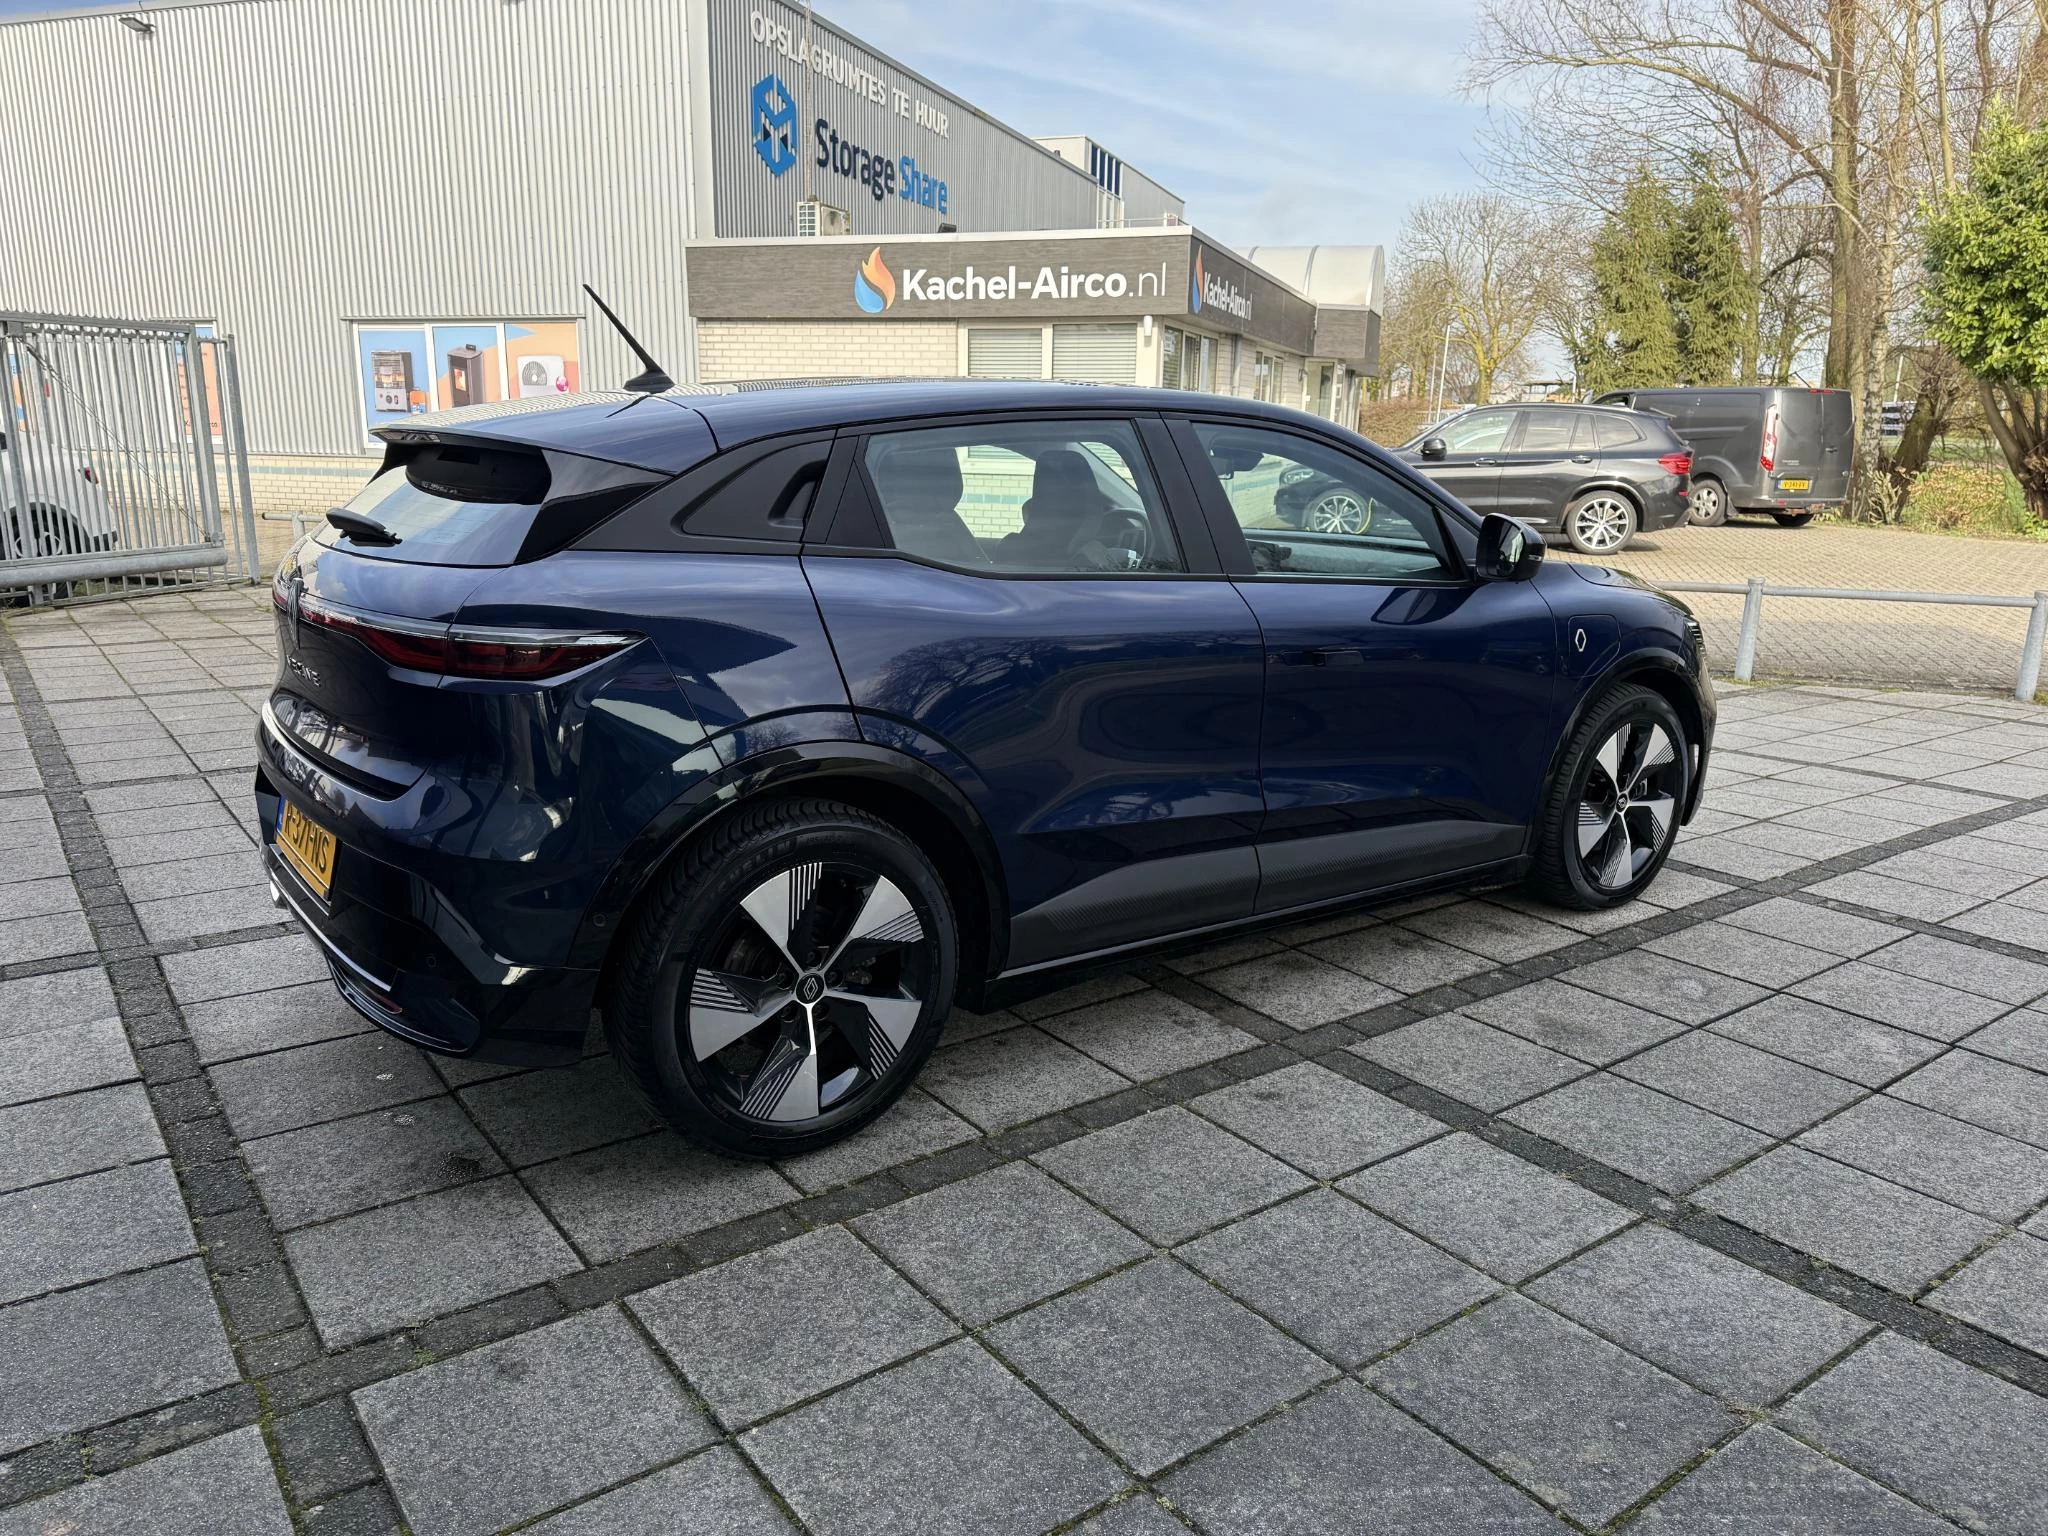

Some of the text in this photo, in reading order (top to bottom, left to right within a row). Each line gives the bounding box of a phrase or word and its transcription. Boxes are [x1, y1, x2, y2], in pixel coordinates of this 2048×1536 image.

[751, 10, 949, 139] OPSLAGRUIMTES TE HUUR
[903, 261, 1167, 300] Kachel-Airco.nl
[1203, 271, 1253, 321] Kachel-Airco.nl
